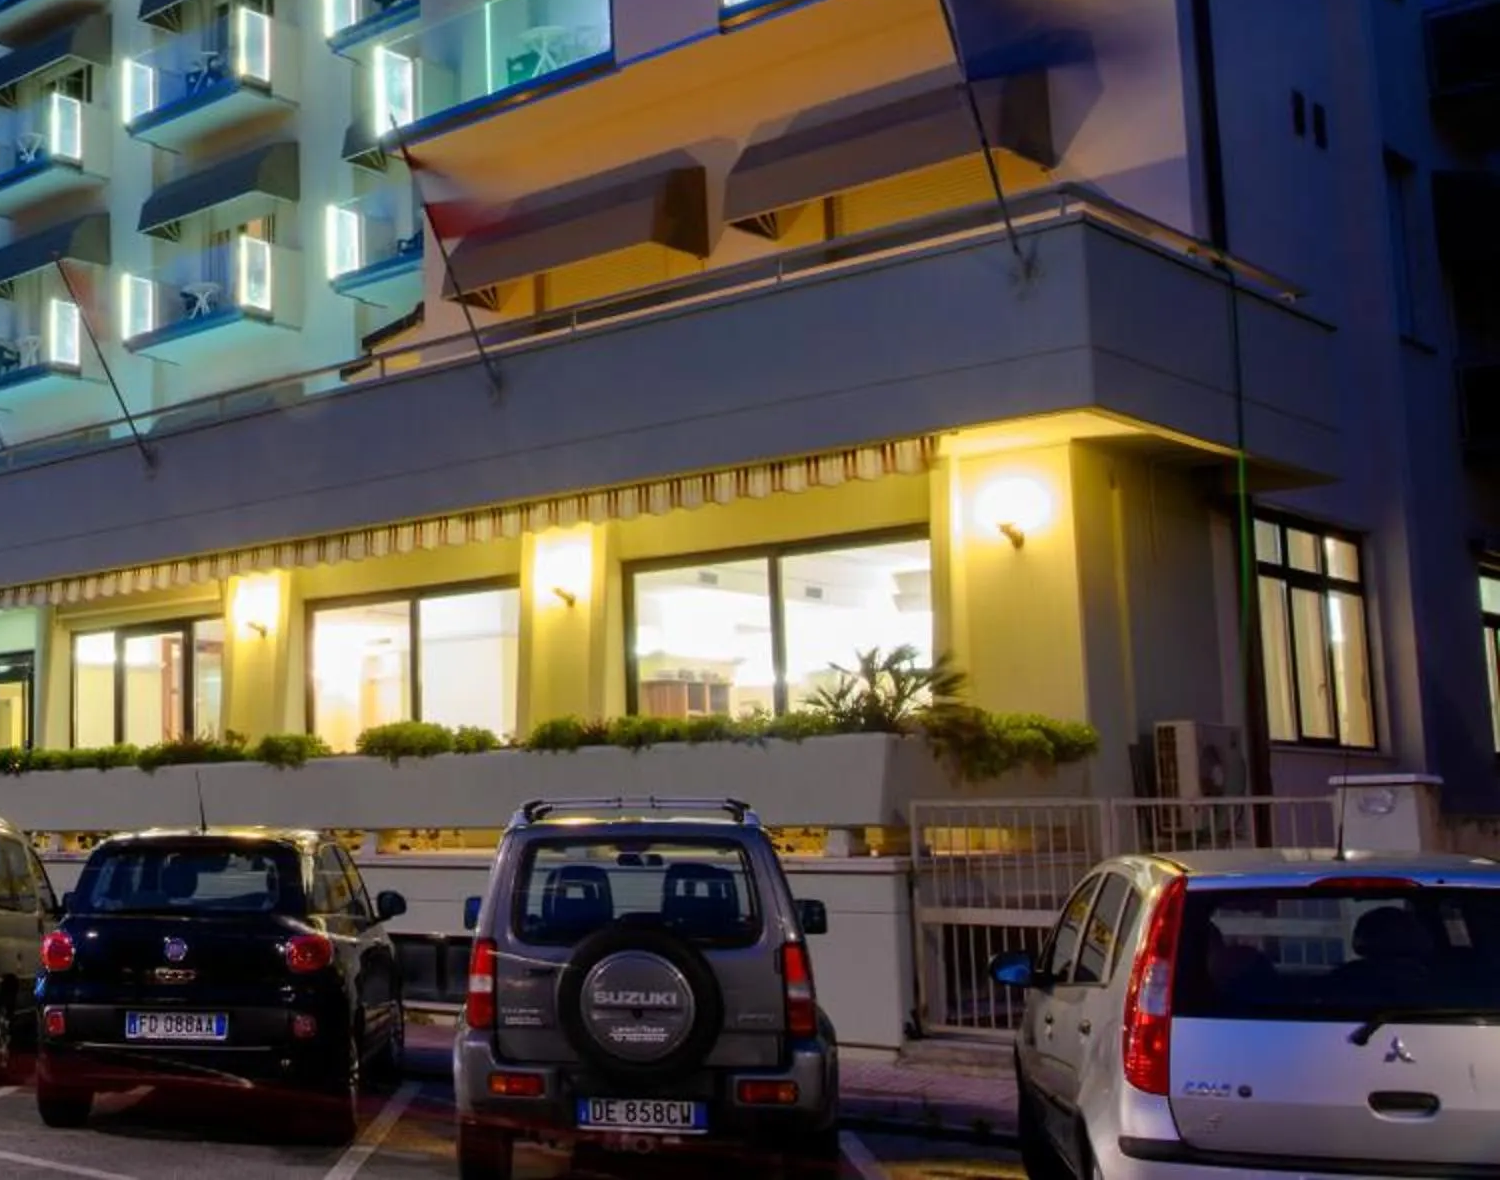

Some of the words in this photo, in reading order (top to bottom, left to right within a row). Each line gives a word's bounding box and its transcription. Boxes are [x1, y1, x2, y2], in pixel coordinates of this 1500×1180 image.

[593, 990, 677, 1006] SUZUKI
[592, 1101, 618, 1123] DE
[625, 1101, 692, 1124] 858CW
